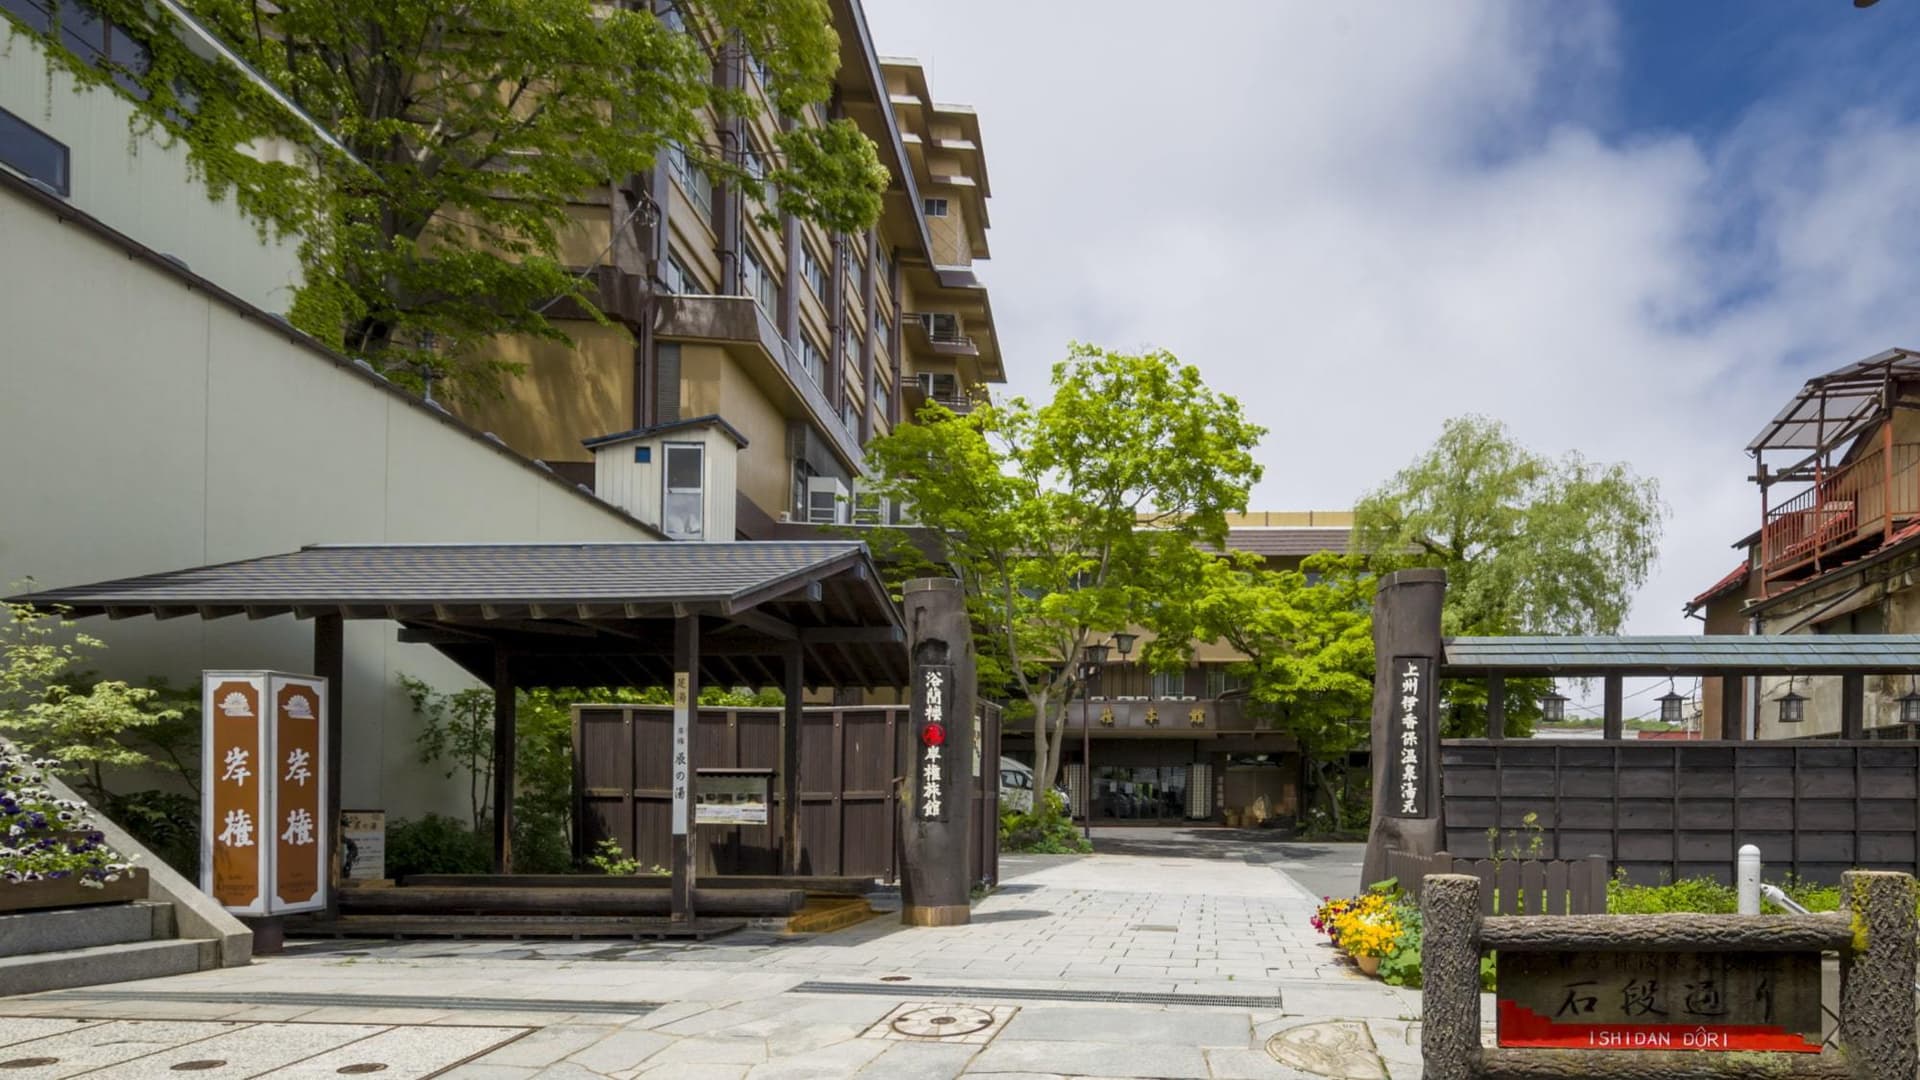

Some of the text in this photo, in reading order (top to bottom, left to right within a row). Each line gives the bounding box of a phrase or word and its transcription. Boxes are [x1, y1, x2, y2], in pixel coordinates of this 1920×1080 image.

[1400, 661, 1420, 814] 上州伊香保温泉湯元
[218, 746, 255, 848] 岸権
[281, 748, 315, 846] 岸権
[1554, 978, 1772, 1023] 石段通り
[1588, 1030, 1671, 1047] ISHIDAN
